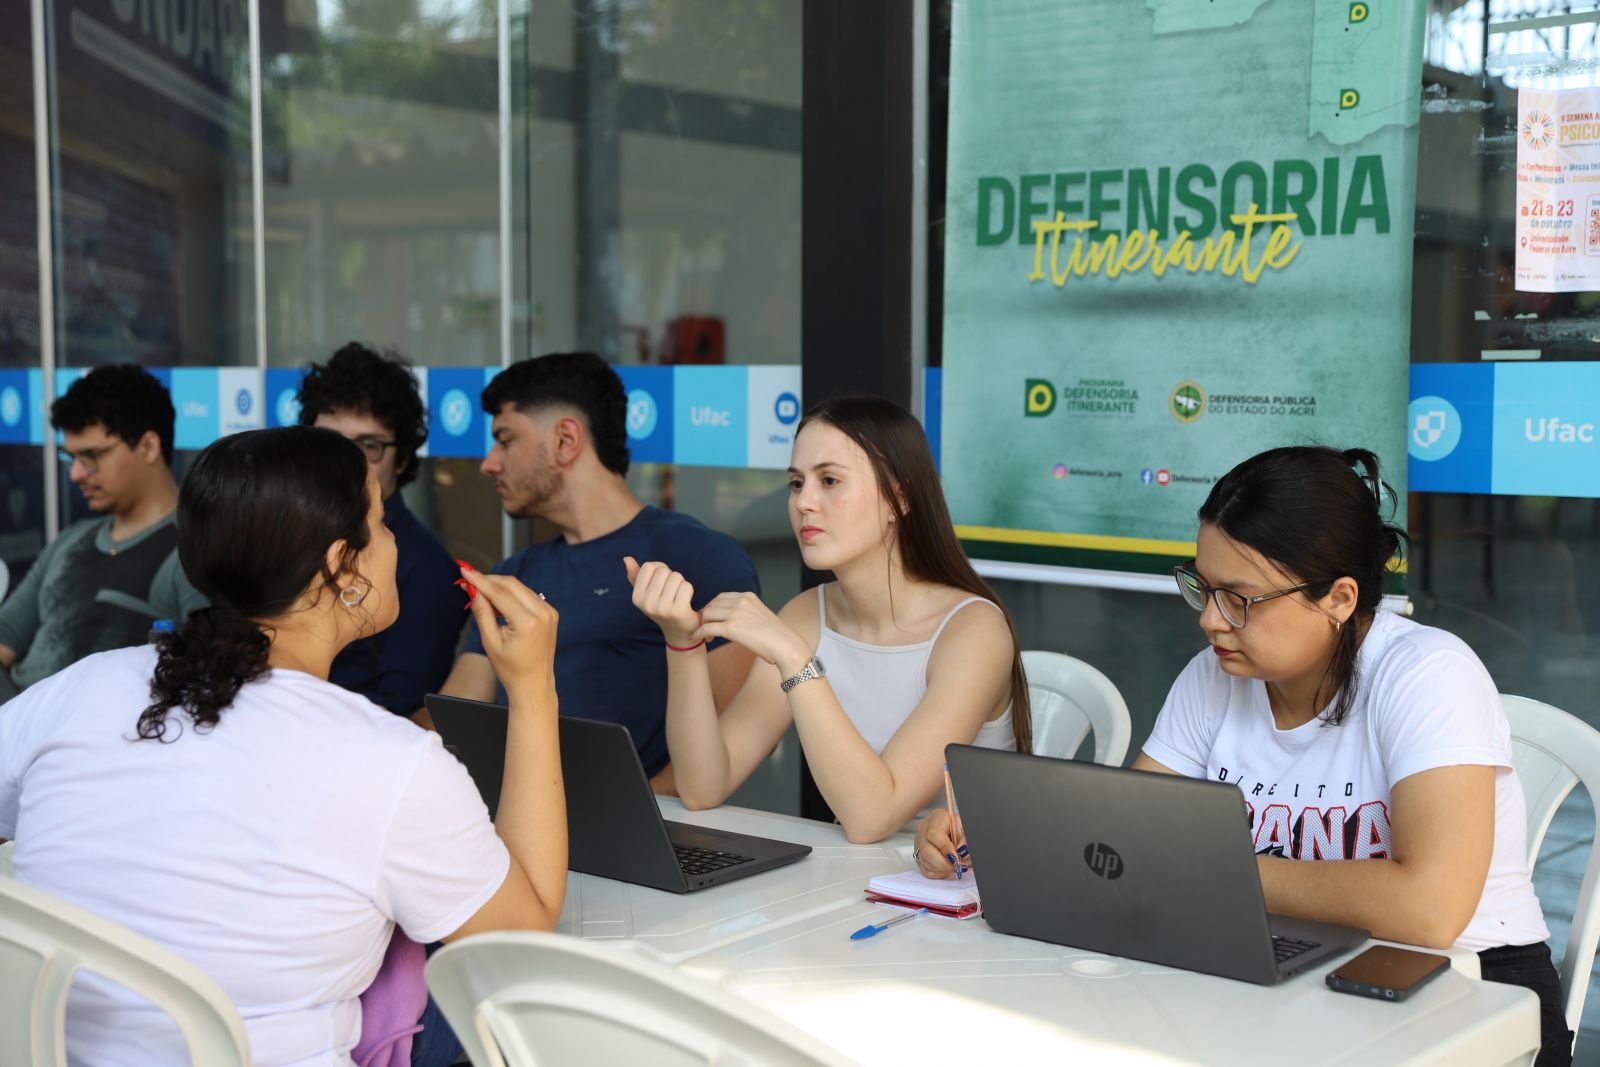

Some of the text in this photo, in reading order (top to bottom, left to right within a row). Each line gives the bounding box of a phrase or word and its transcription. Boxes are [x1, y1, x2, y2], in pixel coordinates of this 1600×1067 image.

[977, 155, 1391, 246] DEFENSORIA
[1532, 200, 1574, 216] 21 a 23
[1541, 219, 1573, 228] outubro
[1028, 202, 1301, 287] Itinerante
[1064, 387, 1139, 400] DEFENSORIA
[1208, 395, 1317, 405] DEFENSORIA PÚBLICA
[1067, 400, 1136, 414] ITINERANTE
[1208, 405, 1317, 416] DO ESTADO DO ACRE
[690, 407, 731, 427] Ufac
[1524, 417, 1595, 443] Ufac
[1172, 474, 1211, 484] Defensoria
[1218, 767, 1353, 798] DIREITO
[1246, 800, 1392, 860] ANA
[1089, 842, 1120, 879] hp
